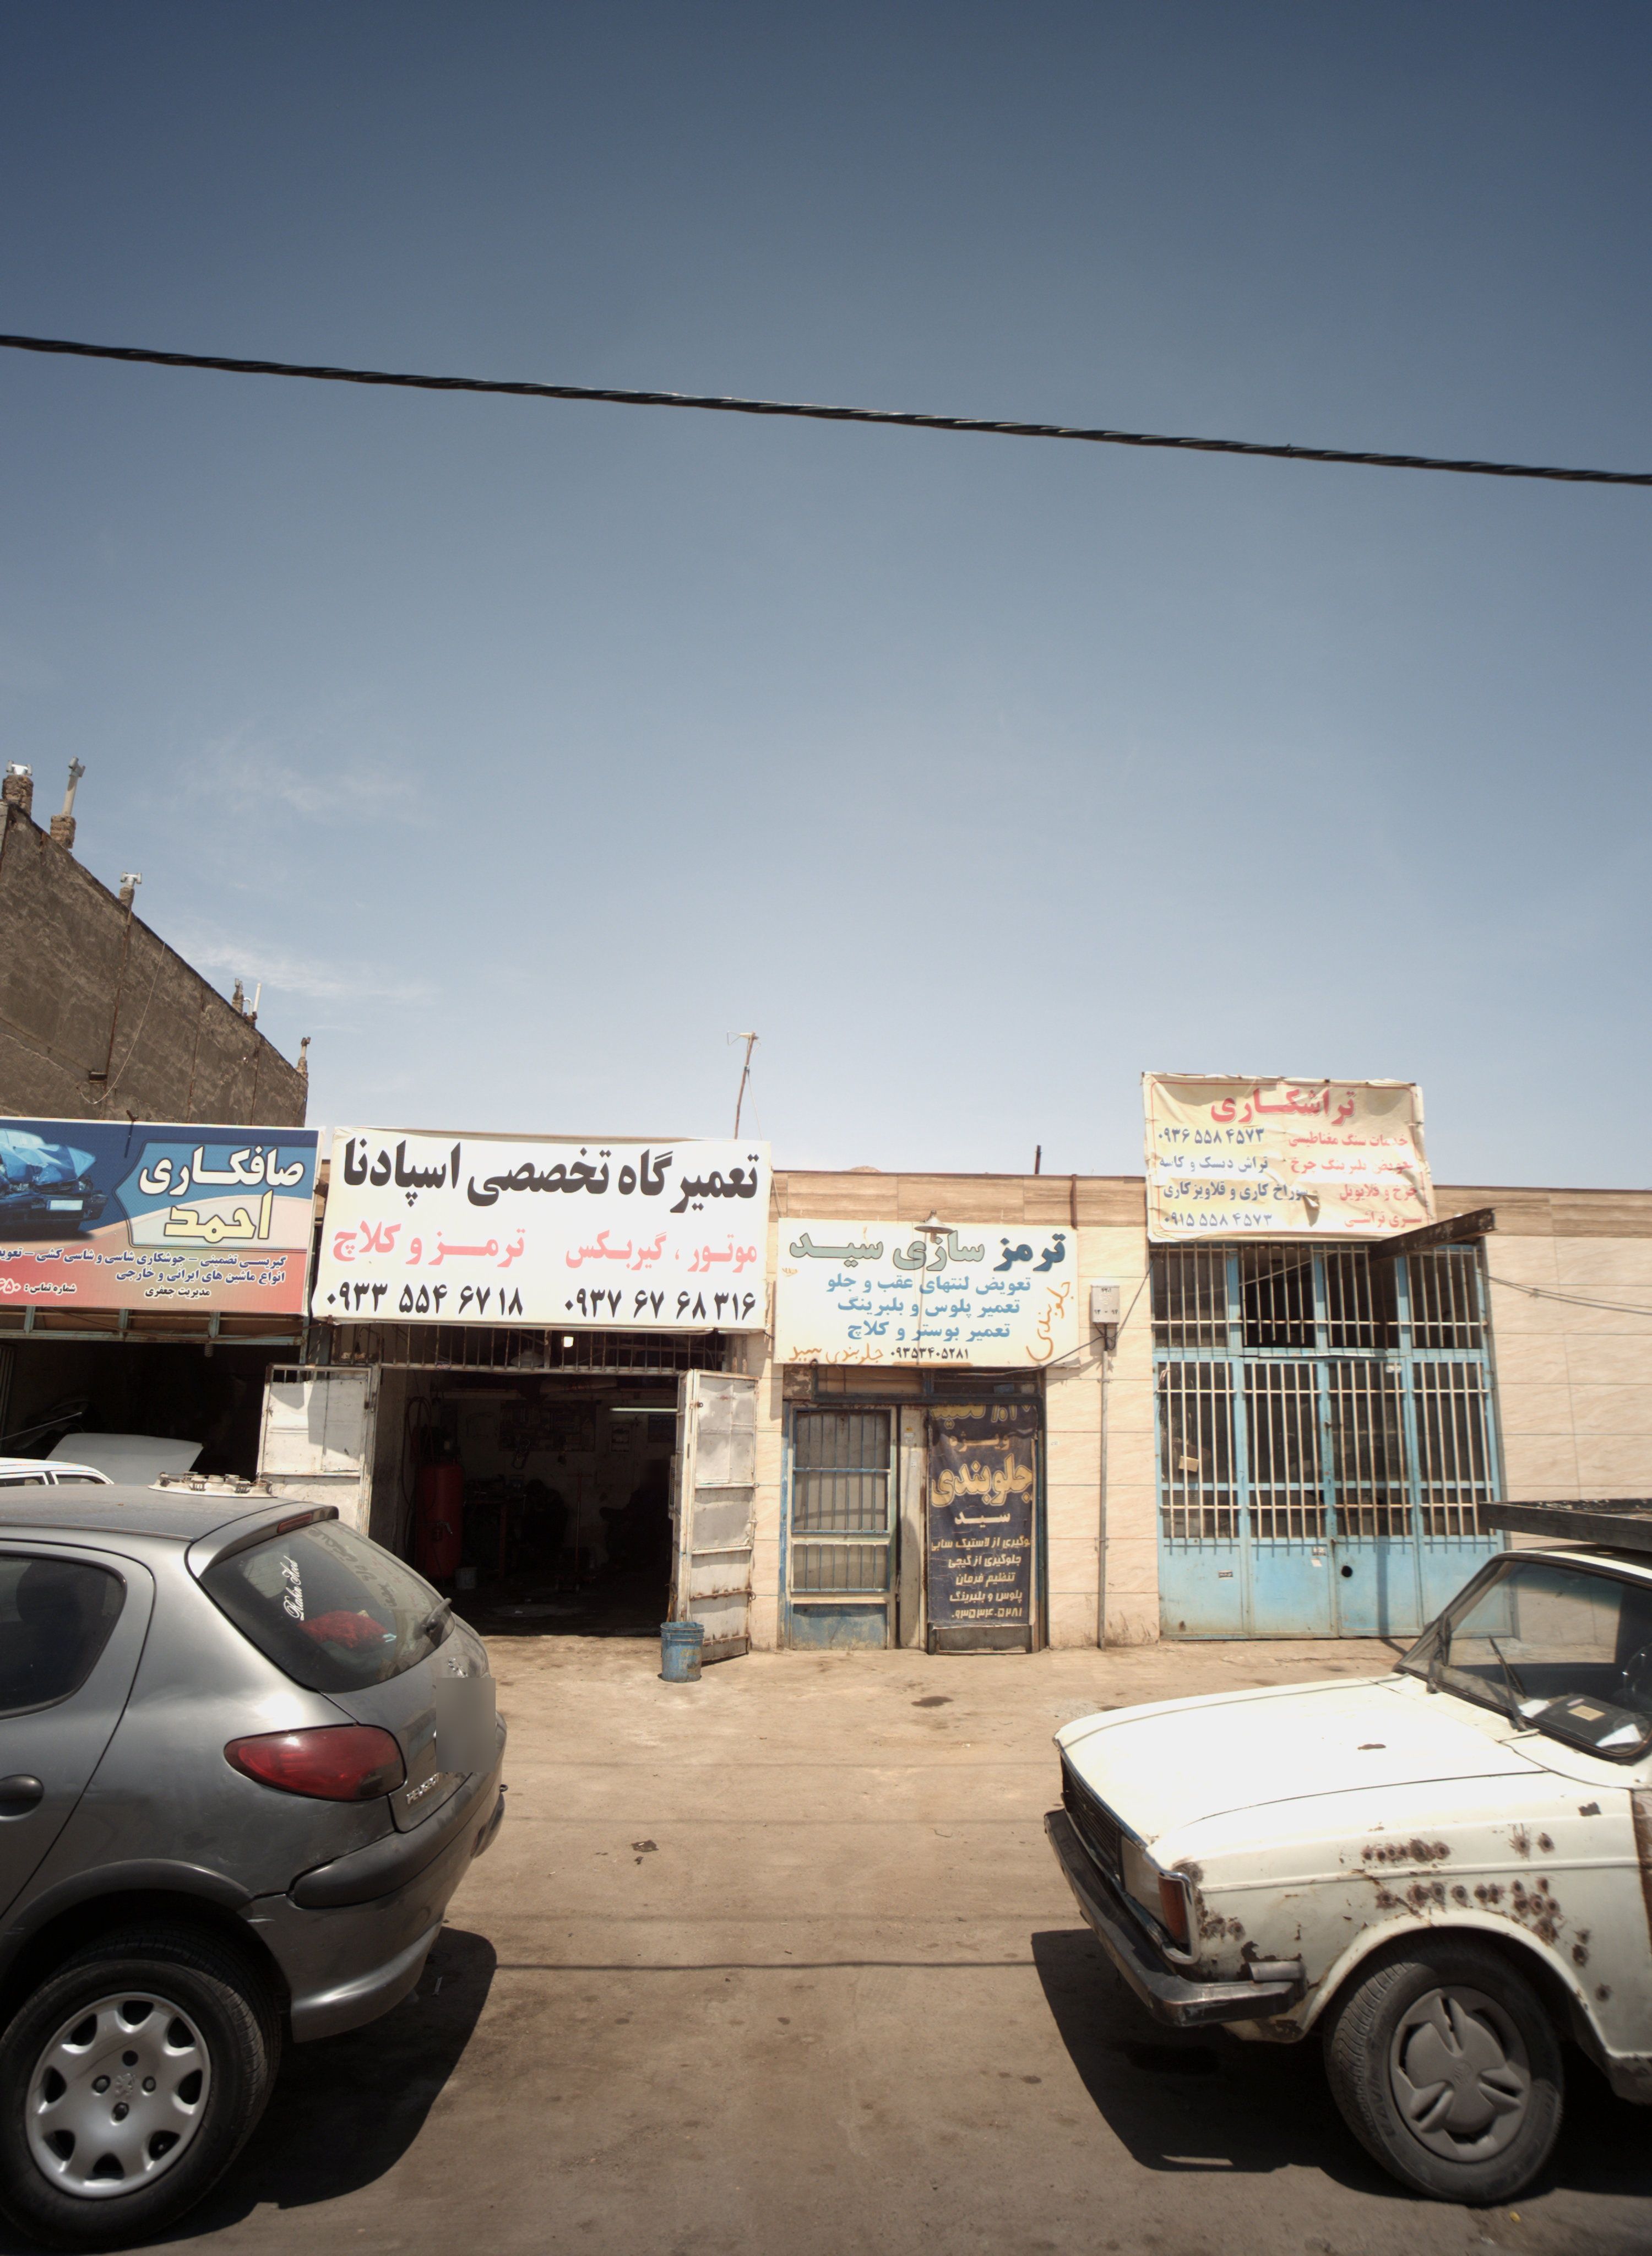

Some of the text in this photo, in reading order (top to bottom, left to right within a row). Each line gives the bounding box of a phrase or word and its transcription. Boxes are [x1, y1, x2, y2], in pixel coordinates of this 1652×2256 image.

[1211, 1087, 1355, 1126] تراشکاری
[1159, 1127, 1265, 1145] ۰۹۳۶ ۵۵۸ ۴۵۷۳
[1289, 1131, 1408, 1148] خمات سنگ مغناطیسی
[139, 1145, 305, 1196] صافکاری
[1190, 1160, 1196, 1172] و
[1199, 1156, 1234, 1170] دیسک
[1238, 1156, 1269, 1173] تراش
[344, 1137, 461, 1207] اسپادنا
[468, 1147, 612, 1207] تخصصی
[1230, 1187, 1236, 1201] و
[1384, 1189, 1389, 1201] و
[164, 1189, 274, 1244] احمد
[1164, 1211, 1272, 1227] ۰۹۱۵ ۵۵۸ ۴۵۷۳
[333, 1220, 525, 1267] ترمز و کلاچ
[566, 1229, 667, 1271] گیربکس
[790, 1230, 1066, 1272] ترمز سازی سید
[0, 1248, 23, 1261] تعوی
[36, 1248, 63, 1262] کشی
[64, 1249, 94, 1262] شاسی
[95, 1254, 102, 1263] و
[104, 1250, 134, 1264] شاسی
[137, 1252, 186, 1267] جوشکاری
[200, 1254, 238, 1267] تضمینی
[687, 1234, 757, 1273] موتور
[116, 1267, 285, 1284] انواع ماشین های ایرانی و خارجی
[30, 1283, 51, 1293] تماس
[53, 1283, 76, 1294] شماره
[826, 1273, 1031, 1295] تعویض لنتهای عقب و جلو
[145, 1287, 210, 1298] مدیریت جعفری
[327, 1281, 388, 1312] ۰۹۳۳
[399, 1283, 448, 1314] ۵۵۴
[565, 1288, 622, 1318] ۰۹۳۷
[633, 1289, 665, 1319] ۶۷
[838, 1295, 1020, 1319] تعمیر پلوس و بلبرینگ
[847, 1320, 1010, 1342] تعمیر بوستر و کلاچ
[789, 1346, 822, 1362] سید
[890, 1346, 969, 1359] ۰۹۳۵۳۴۰۵۲۸۱
[949, 1431, 1010, 1453] ویژه
[931, 1453, 1034, 1507] جلوبندی
[954, 1511, 1011, 1528] سید
[955, 1537, 990, 1550] لاستیک
[991, 1536, 1001, 1548] از
[973, 1555, 983, 1567] از
[983, 1553, 1022, 1568] جلوگیری
[955, 1571, 1016, 1588] تنظیم فرمان
[949, 1589, 1023, 1604] پلوس و بلبرینگ
